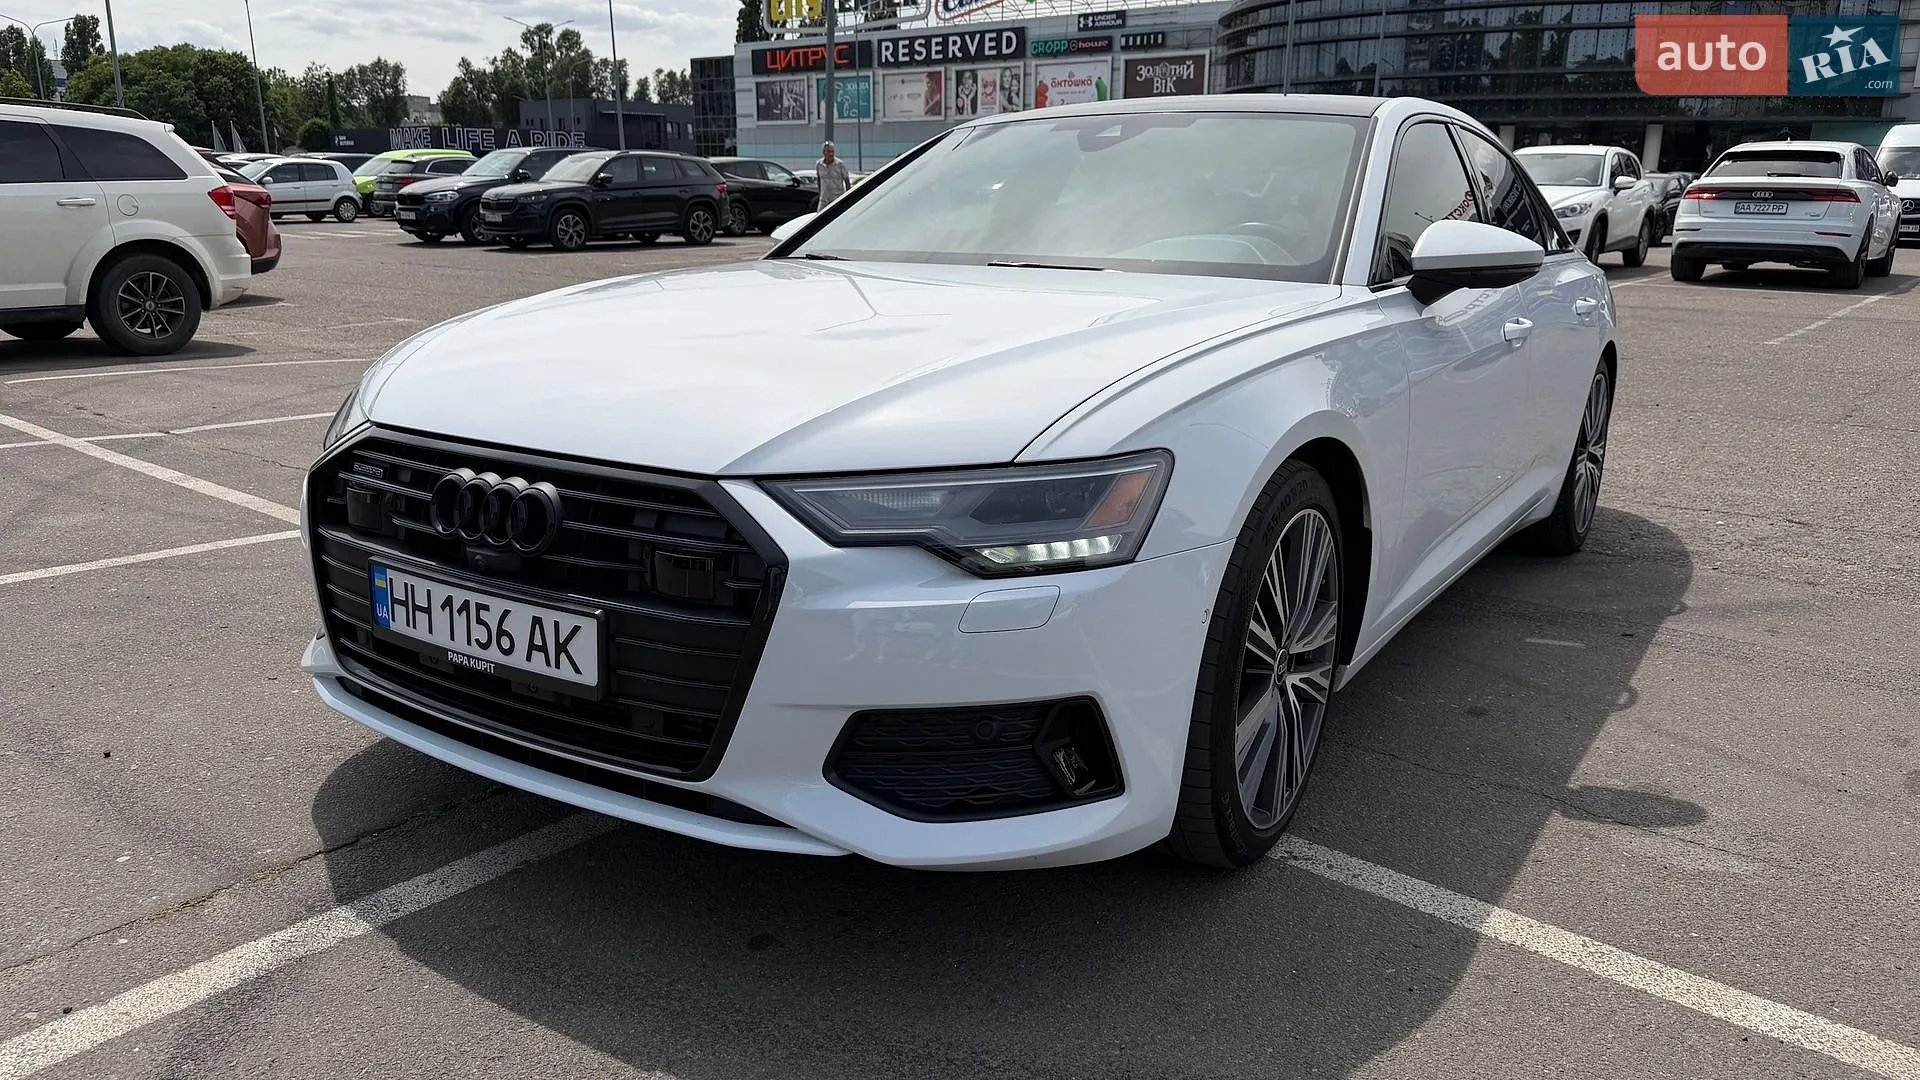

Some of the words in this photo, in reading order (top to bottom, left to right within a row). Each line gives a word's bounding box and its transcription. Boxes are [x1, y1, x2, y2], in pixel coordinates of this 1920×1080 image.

[881, 31, 1017, 63] RESERVED
[1031, 40, 1068, 55] CROPP
[1153, 77, 1176, 94] ВІК
[389, 127, 431, 149] MAKE
[441, 128, 495, 150] LIFE
[506, 129, 523, 148] A
[530, 130, 585, 148] RIDE
[376, 605, 389, 620] UA
[388, 577, 433, 636] HH
[440, 594, 516, 656] 1156
[525, 615, 583, 675] AK
[447, 651, 469, 667] PAPA
[470, 658, 496, 673] KUPIT
